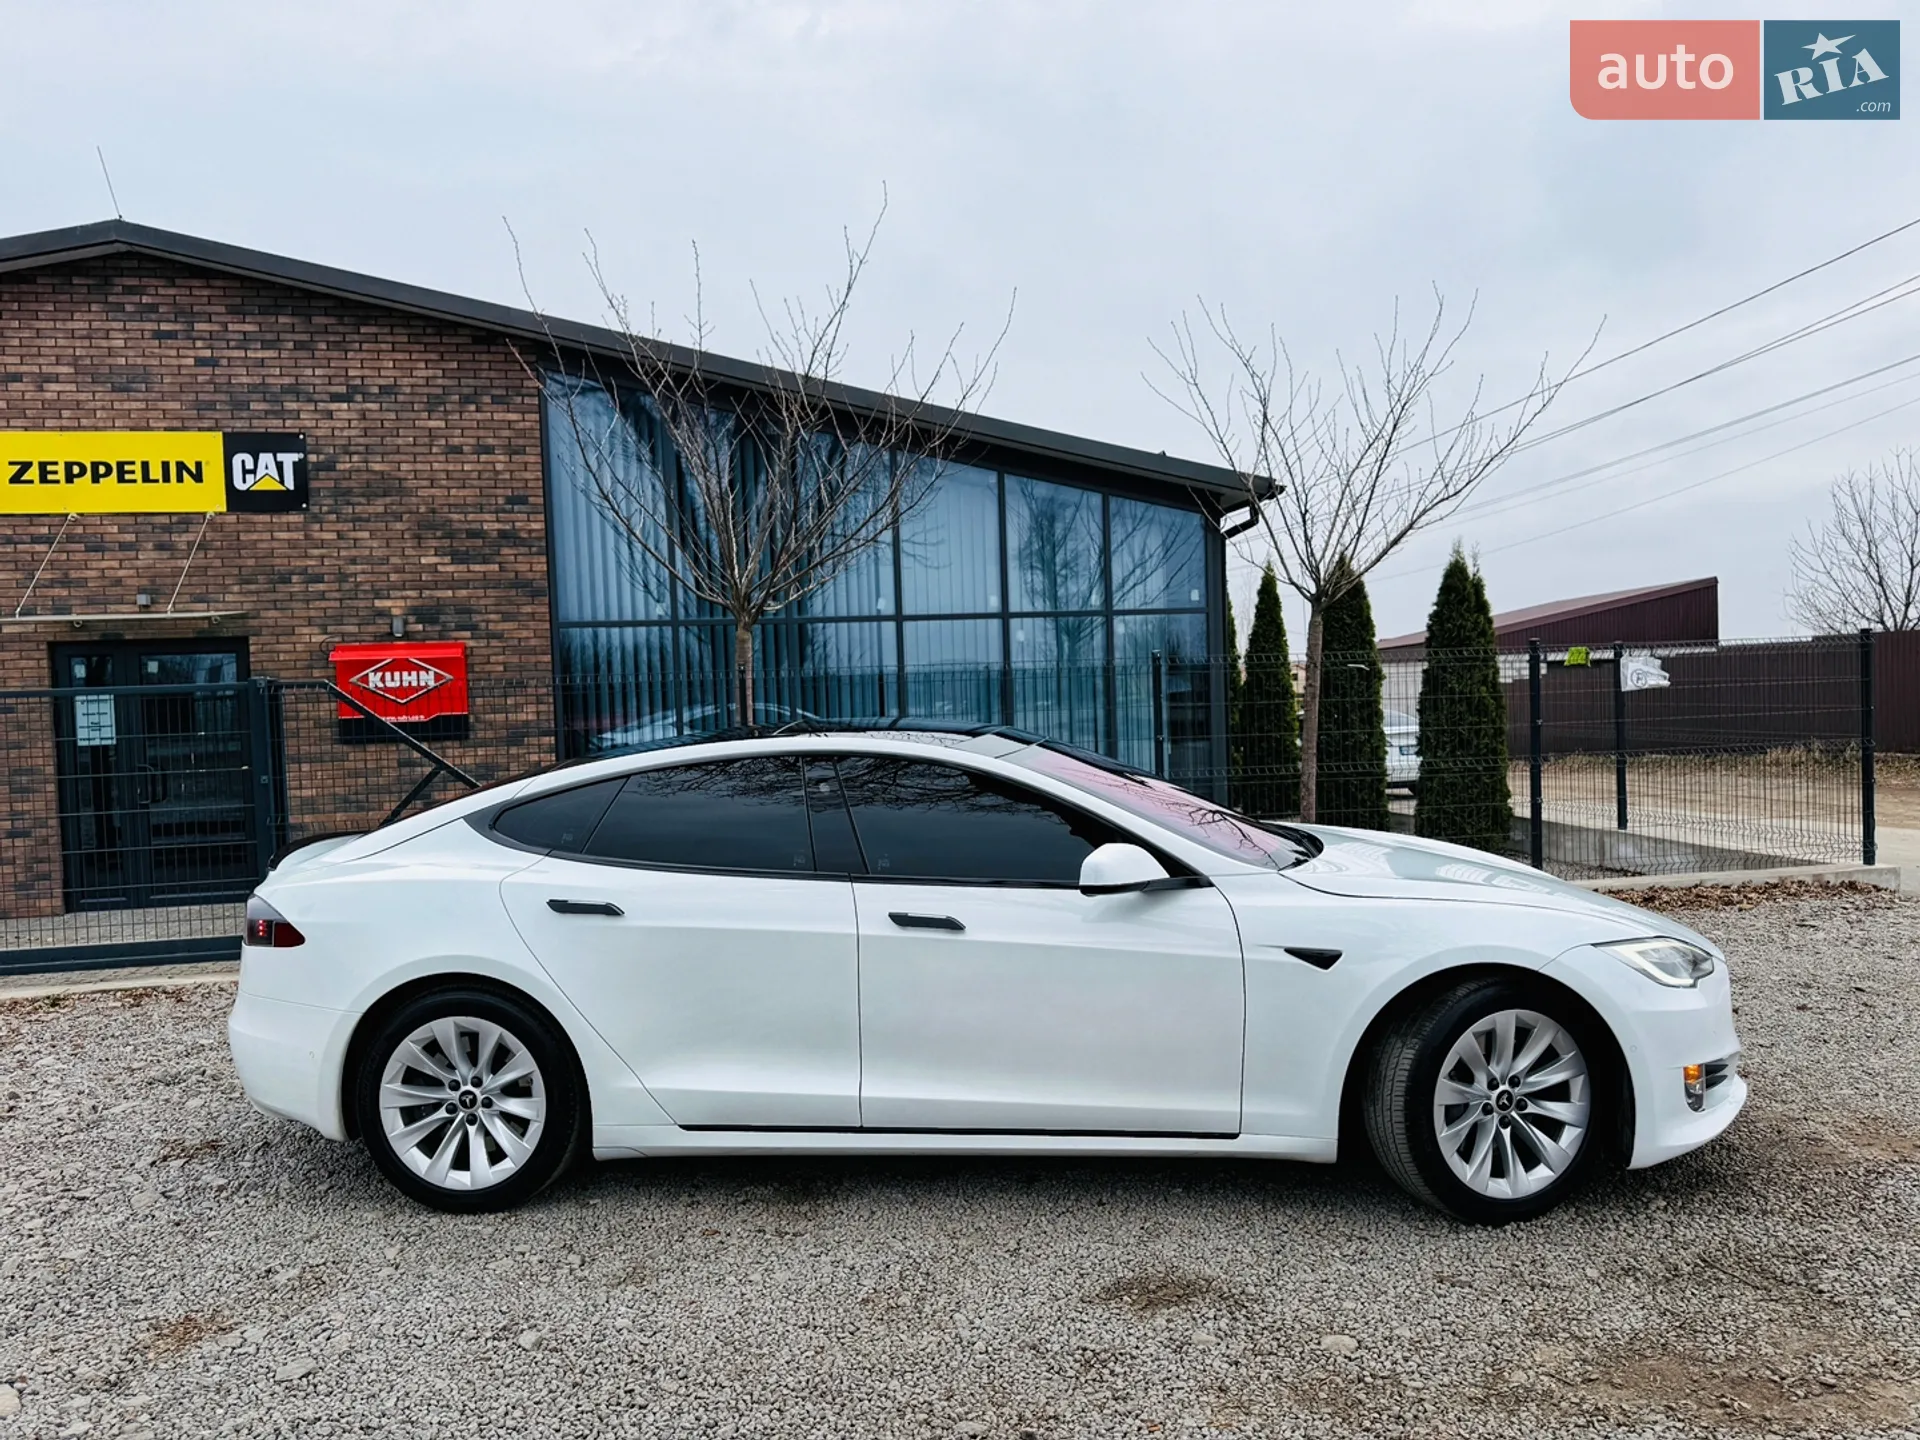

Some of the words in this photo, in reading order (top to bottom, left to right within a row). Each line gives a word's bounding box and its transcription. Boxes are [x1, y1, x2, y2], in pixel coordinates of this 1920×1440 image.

[8, 460, 204, 485] ZEPPELIN
[231, 452, 300, 491] CAT
[368, 670, 435, 689] KUHN
